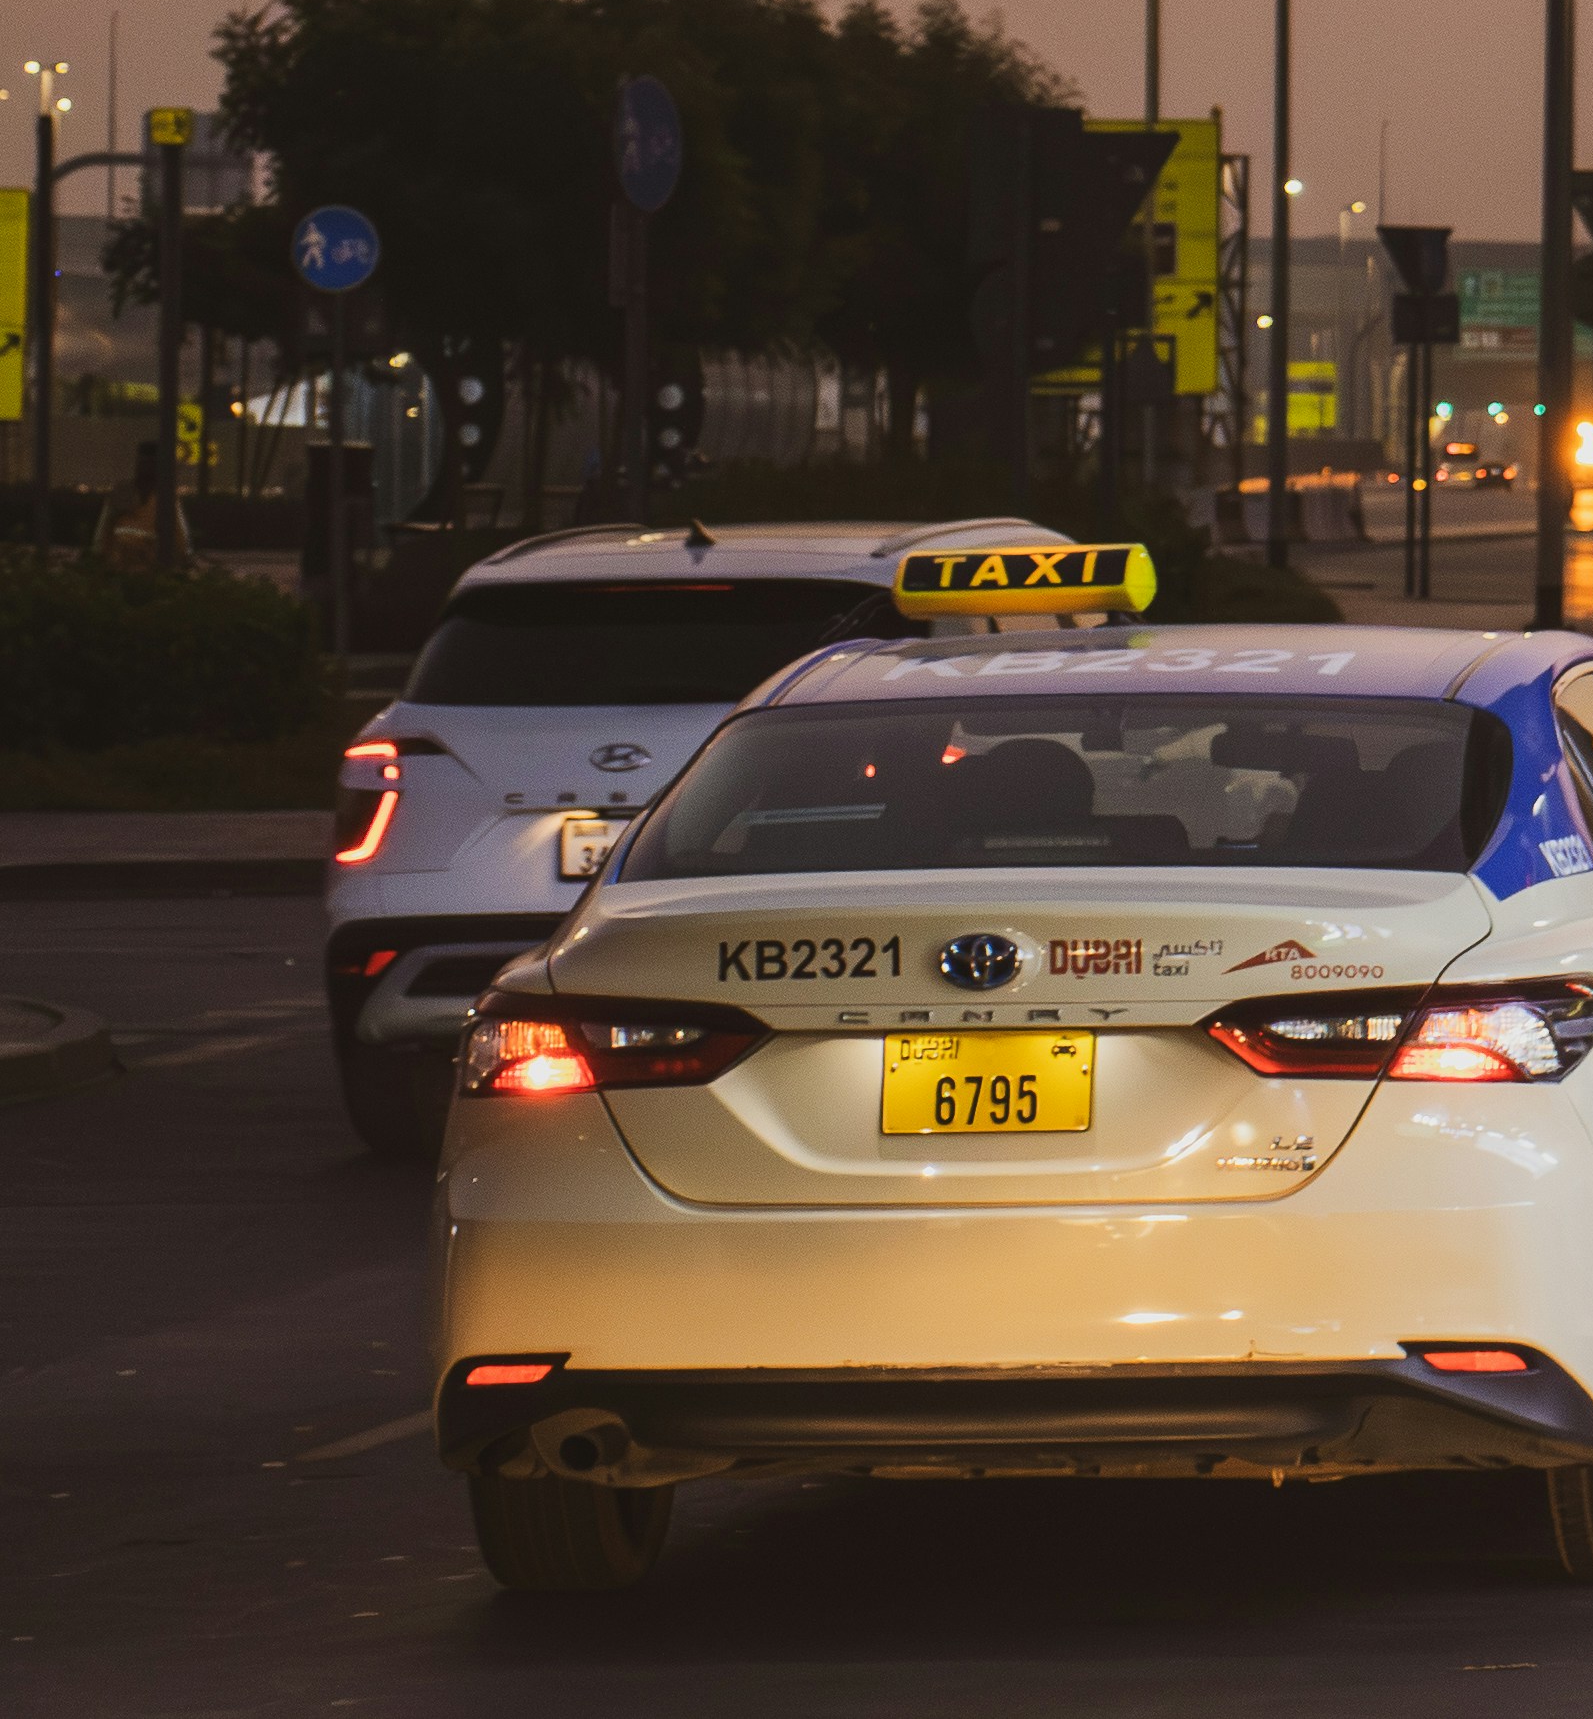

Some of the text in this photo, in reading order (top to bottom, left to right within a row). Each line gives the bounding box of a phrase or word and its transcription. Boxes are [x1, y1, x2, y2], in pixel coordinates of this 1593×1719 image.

[934, 552, 1098, 587] TAXI
[882, 649, 1357, 681] KB2321
[718, 935, 900, 981] KB2321
[1049, 938, 1142, 979] DUBAI
[1153, 960, 1190, 977] taxi
[1290, 964, 1384, 979] 8009090
[934, 1074, 1038, 1127] 6795
